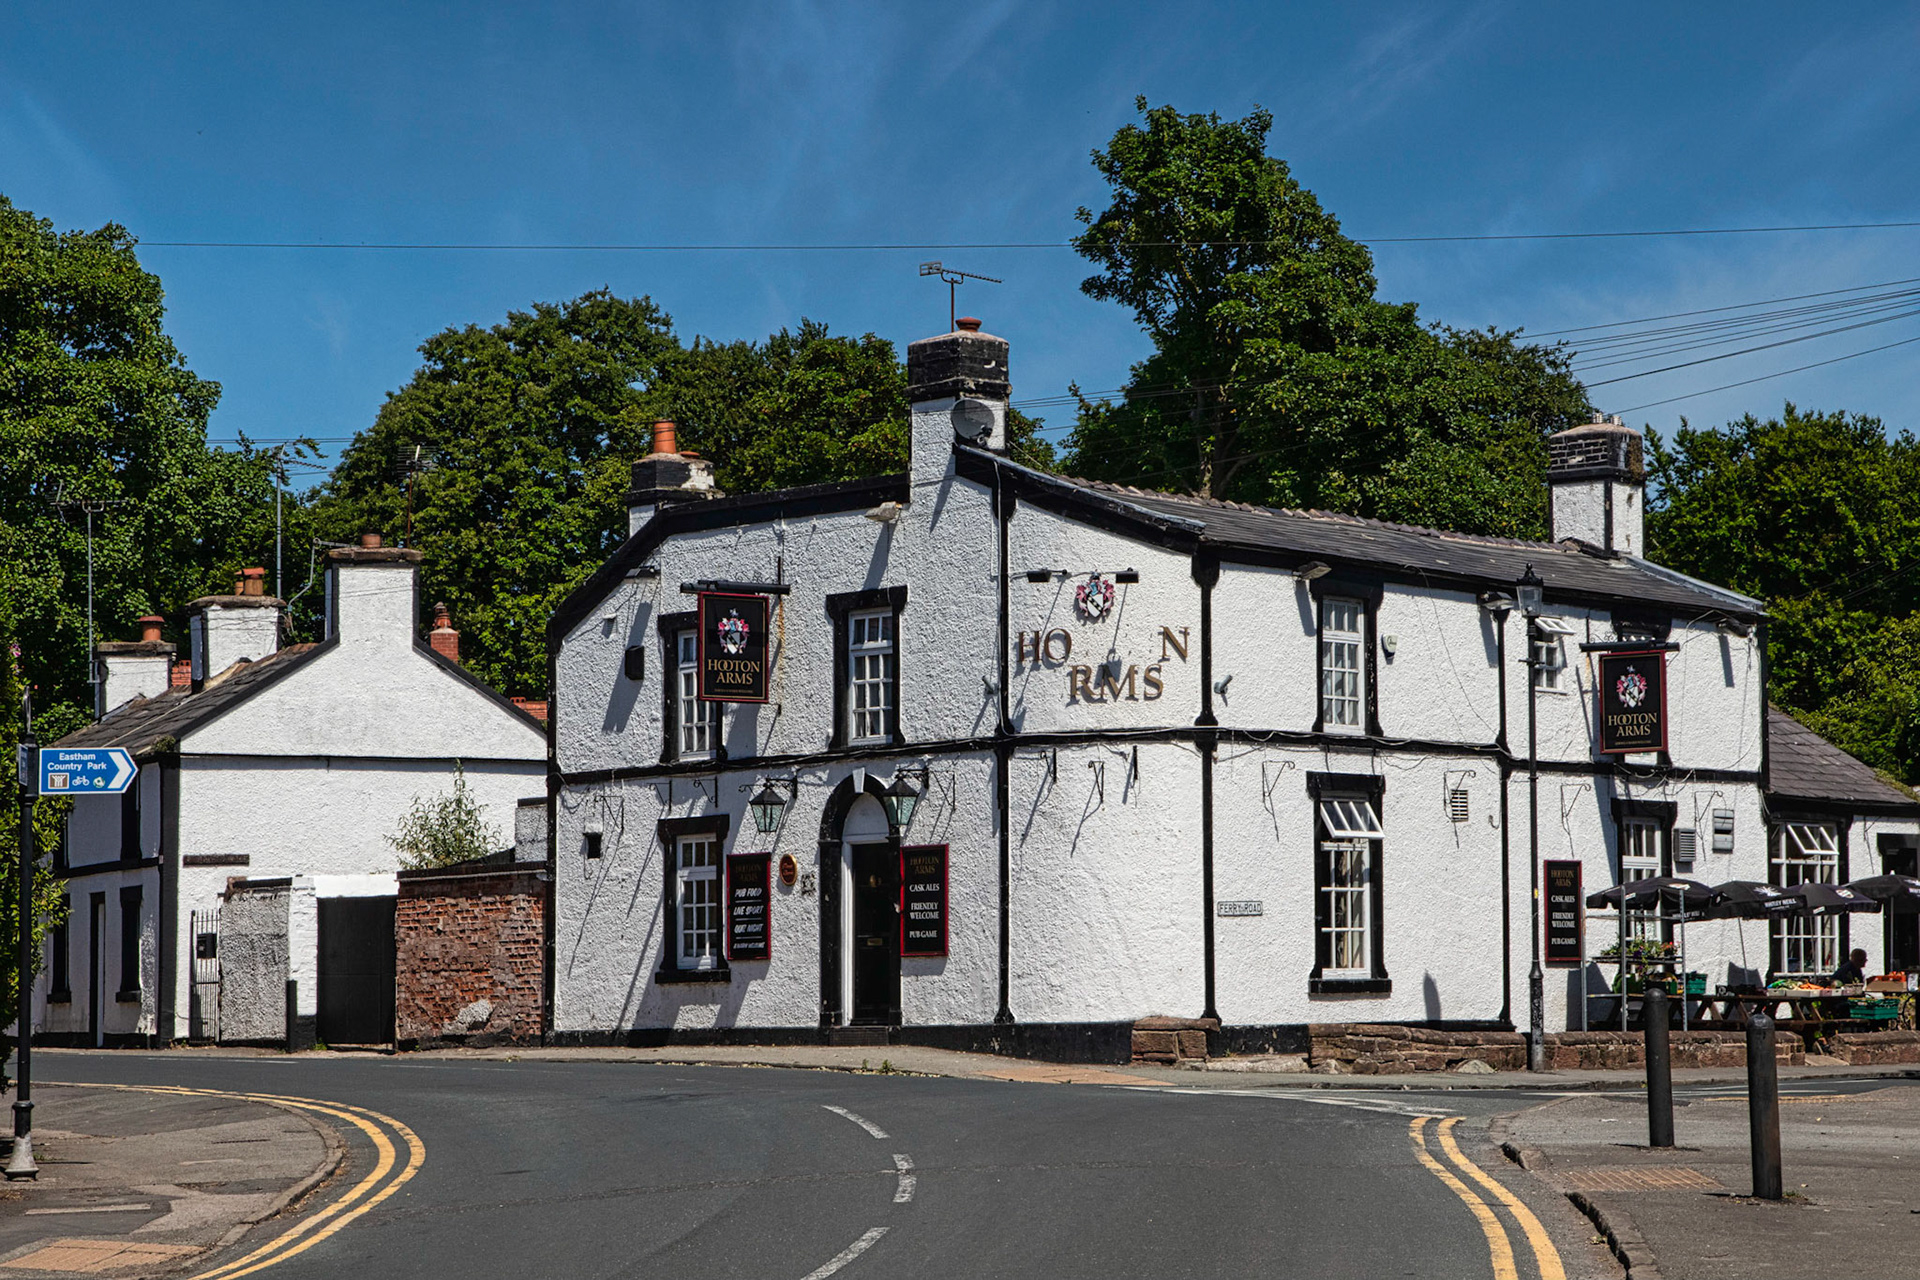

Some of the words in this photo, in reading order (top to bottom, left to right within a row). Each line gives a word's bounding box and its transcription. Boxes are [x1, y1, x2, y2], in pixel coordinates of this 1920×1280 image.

[707, 659, 760, 673] HOOTON
[716, 672, 753, 685] ARMS
[1069, 663, 1165, 699] RMS
[1608, 713, 1657, 726] HOOTON
[1616, 724, 1651, 737] ARMS
[47, 762, 82, 771] Country
[87, 762, 107, 770] Park
[909, 884, 925, 892] CASK
[926, 883, 940, 891] ALES
[910, 902, 939, 911] FRIENDLY
[1219, 903, 1241, 913] FERRY
[1244, 903, 1261, 913] ROAD
[909, 911, 940, 920] WELCOME
[1552, 912, 1575, 920] FRIENDLY
[909, 931, 921, 939] PUB
